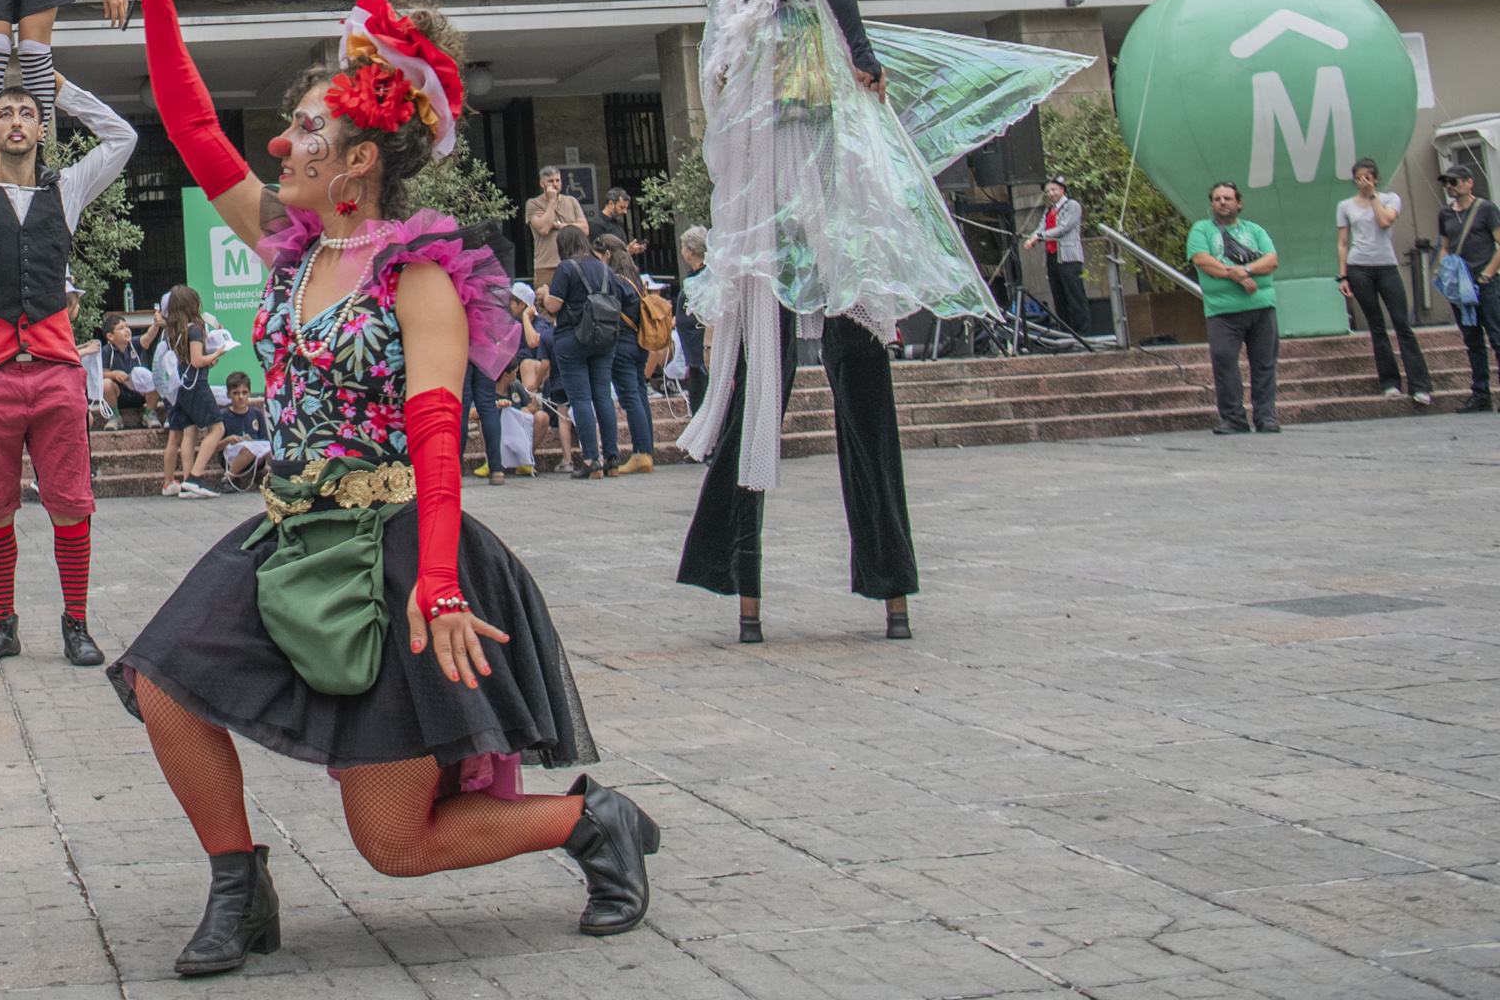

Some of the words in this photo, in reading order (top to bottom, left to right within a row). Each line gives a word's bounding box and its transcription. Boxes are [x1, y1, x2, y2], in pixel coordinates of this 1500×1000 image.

[1248, 65, 1357, 189] M
[224, 248, 250, 277] M
[214, 299, 261, 311] Montevide
